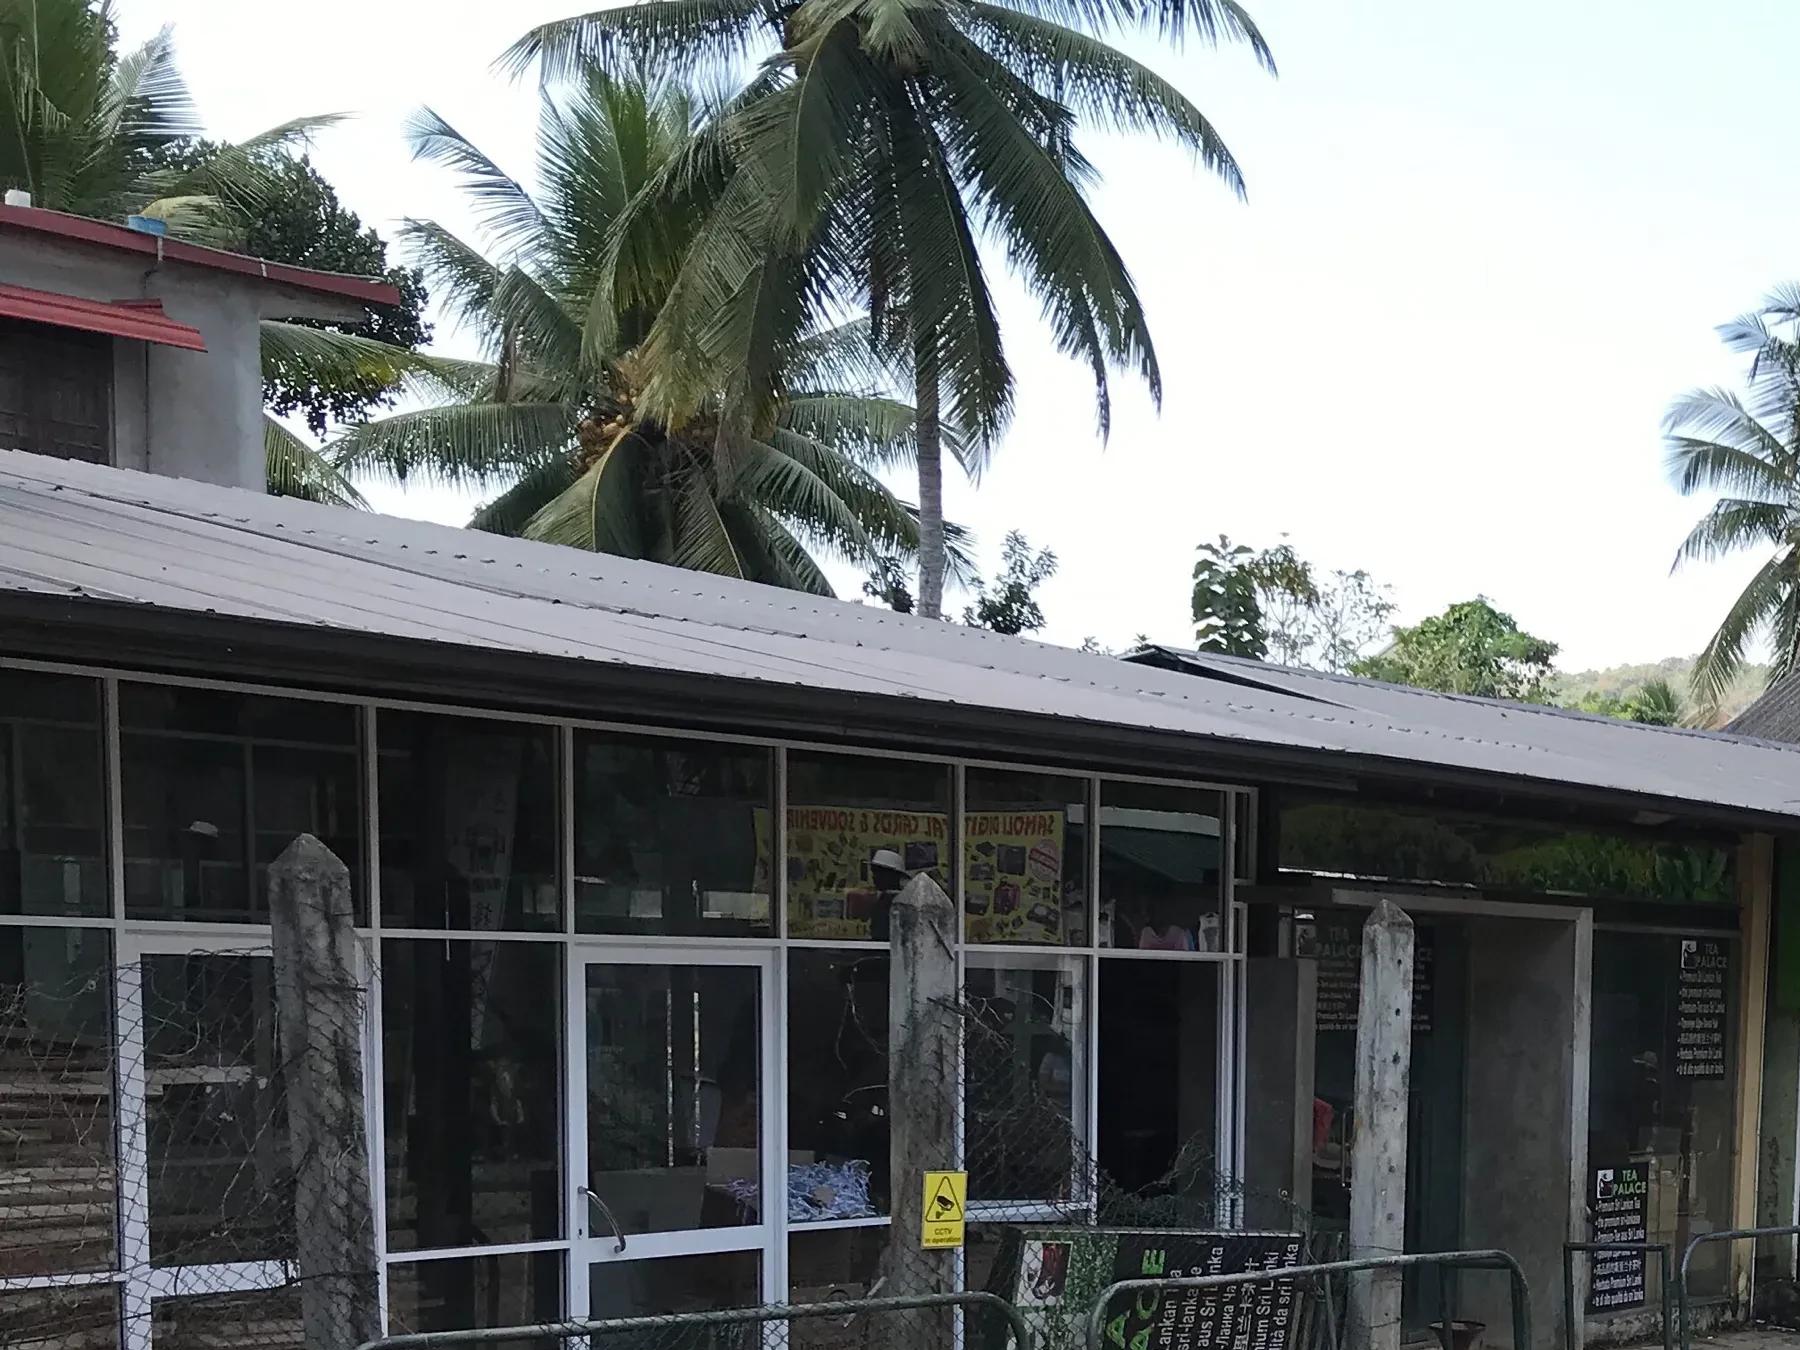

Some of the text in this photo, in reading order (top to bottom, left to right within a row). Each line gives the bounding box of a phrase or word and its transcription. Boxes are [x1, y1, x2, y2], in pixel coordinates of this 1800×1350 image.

[1622, 1169, 1638, 1182] TEA
[1613, 1181, 1647, 1196] PALACE
[934, 1228, 952, 1236] CCTV
[1203, 1247, 1223, 1291] Lnka
[1260, 1251, 1280, 1291] Lnki
[1256, 1295, 1272, 1316] Sri
[1277, 1286, 1293, 1305] sri
[1199, 1296, 1218, 1317] Sri
[1272, 1308, 1288, 1326] da
[1196, 1321, 1213, 1347] aus
